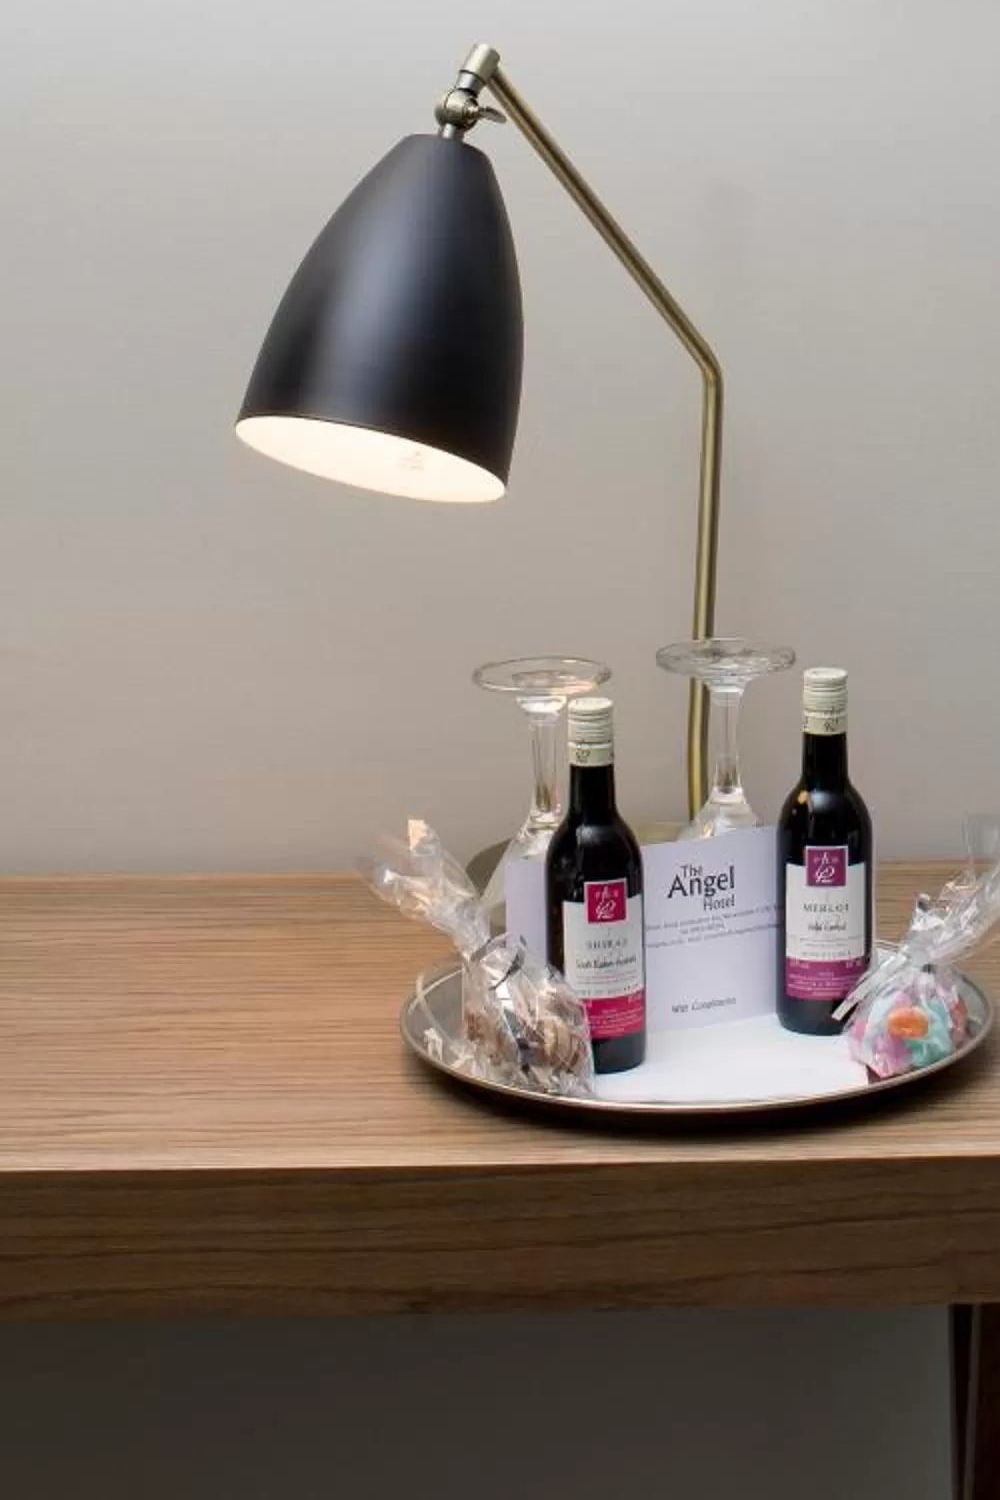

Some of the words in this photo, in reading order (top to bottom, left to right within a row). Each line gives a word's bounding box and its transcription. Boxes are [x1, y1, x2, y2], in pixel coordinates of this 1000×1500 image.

[680, 864, 702, 878] The
[667, 865, 735, 898] Angel
[703, 894, 735, 911] Hotel
[803, 903, 849, 913] MERLOT
